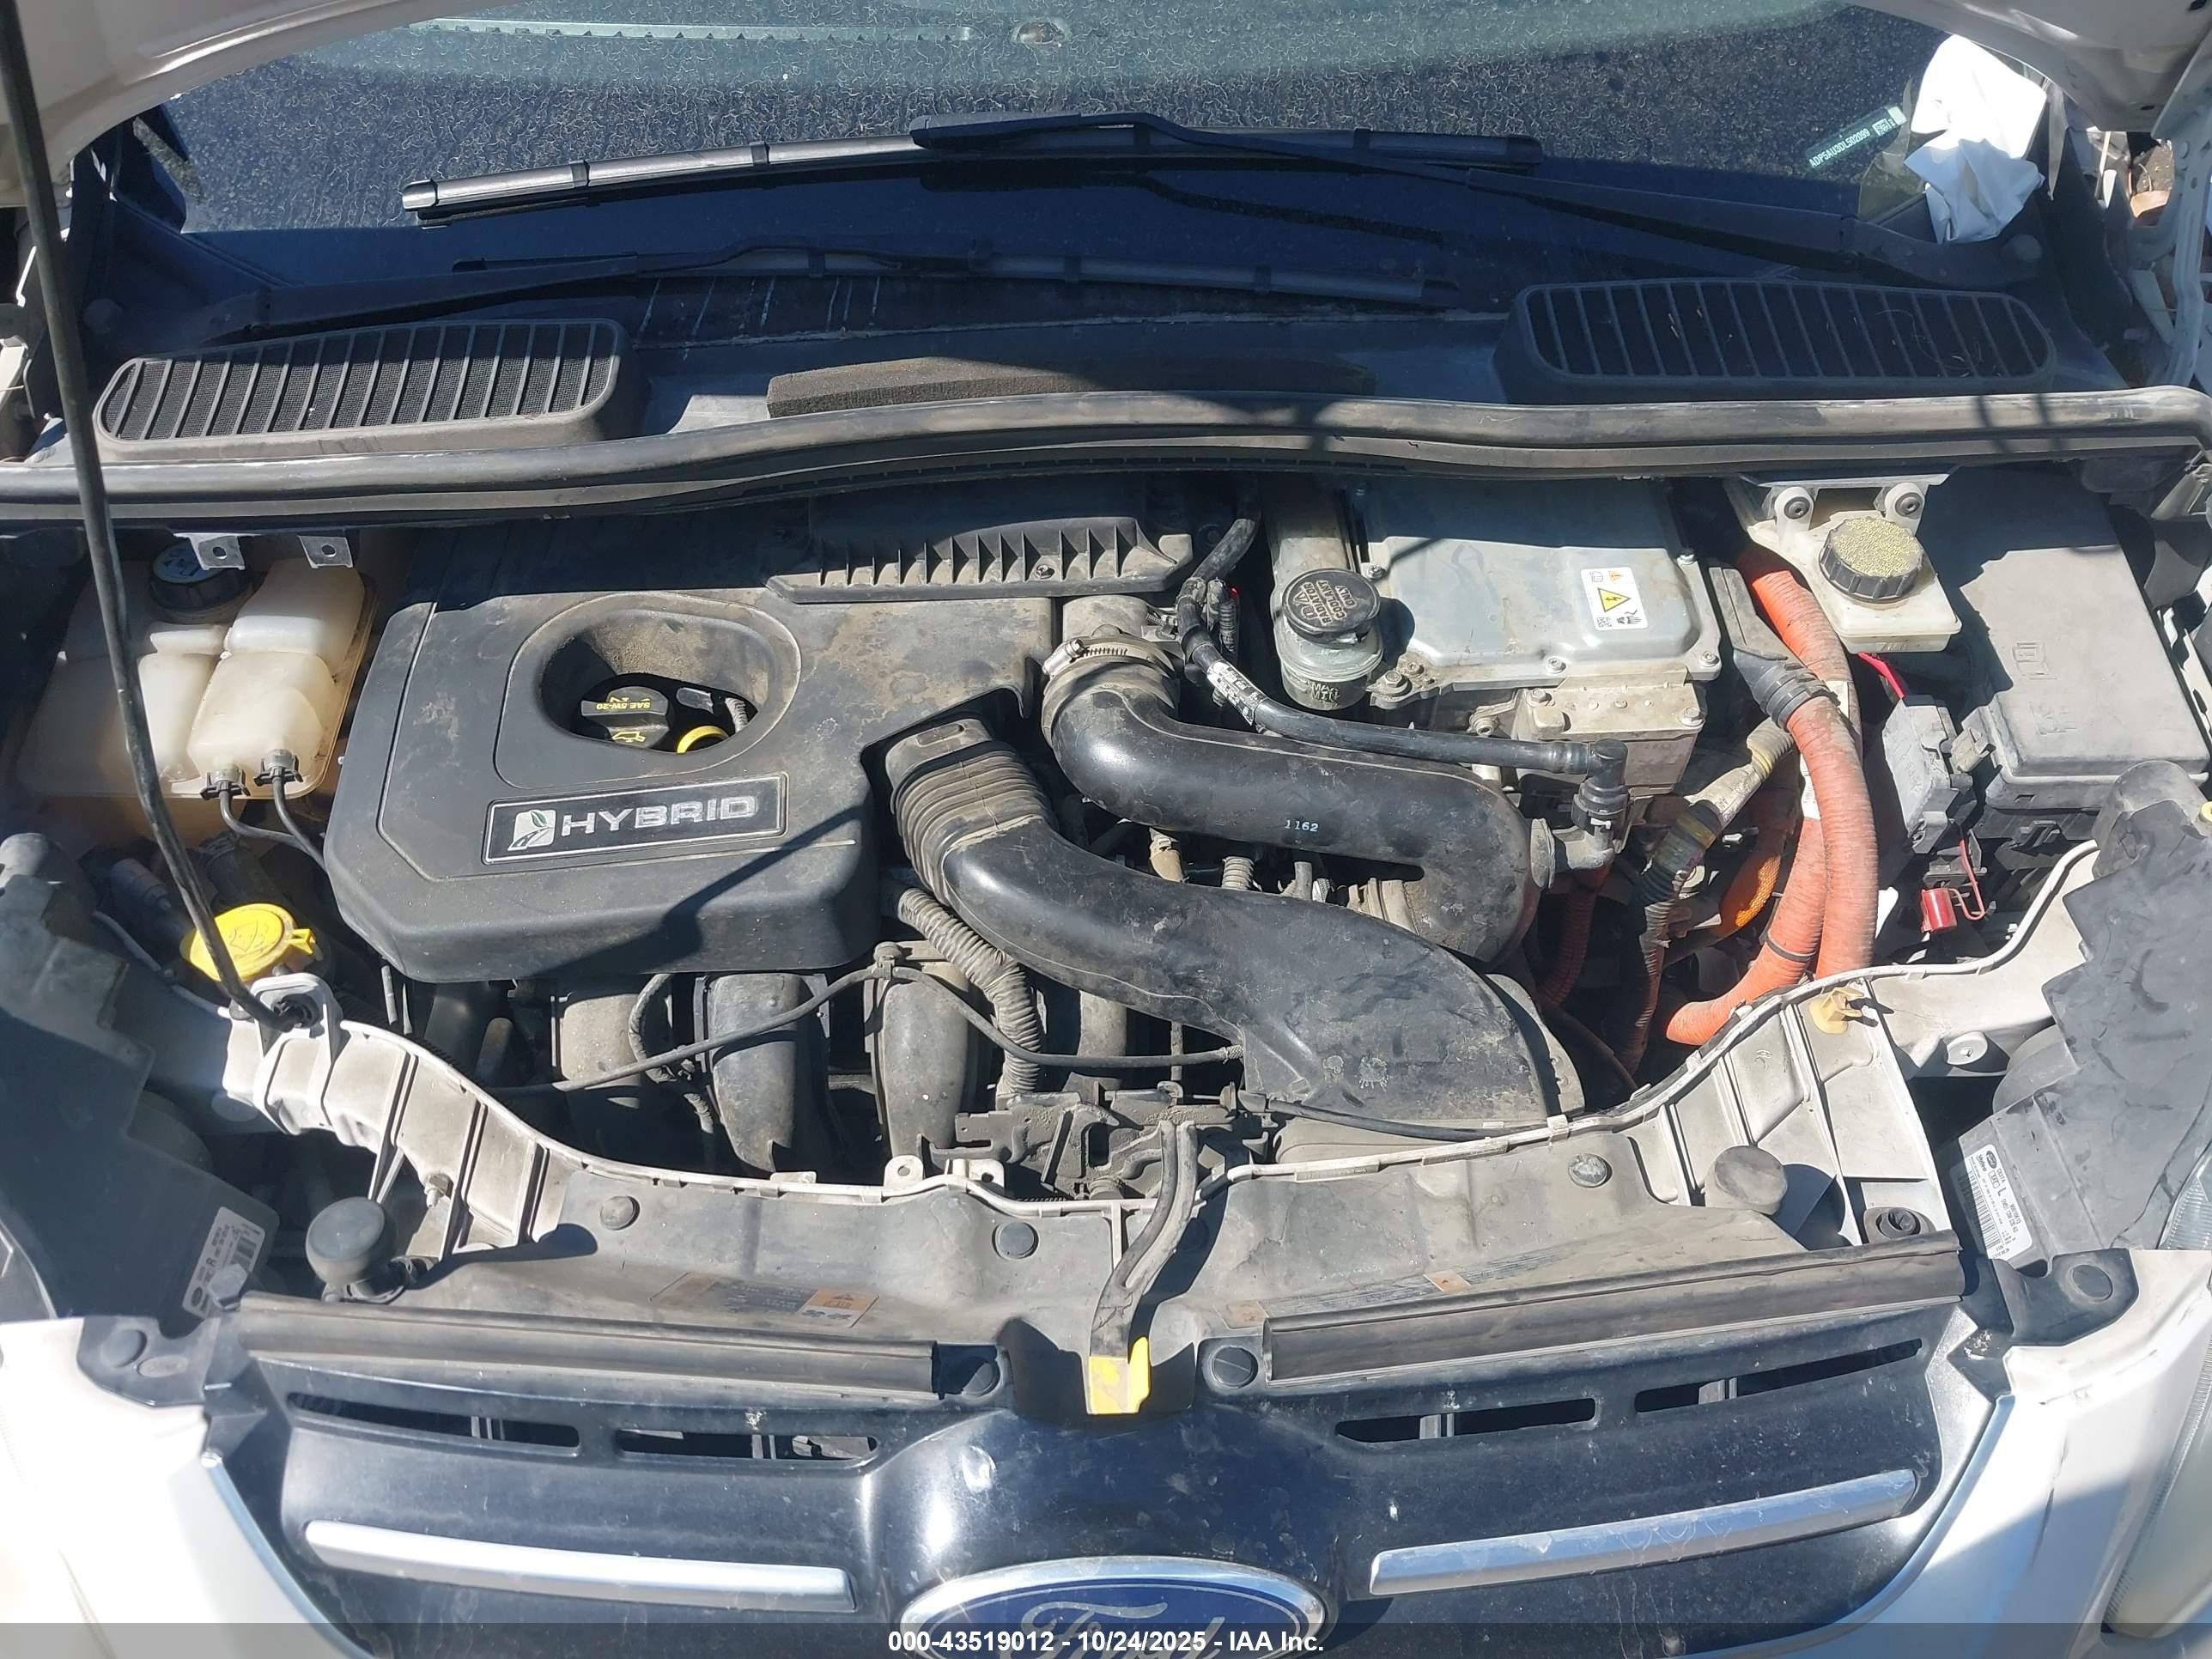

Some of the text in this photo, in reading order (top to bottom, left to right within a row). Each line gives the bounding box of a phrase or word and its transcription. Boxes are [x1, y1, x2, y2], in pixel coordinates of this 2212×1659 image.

[1303, 582, 1333, 625] RADIATOR
[1317, 580, 1346, 619] COOLANT
[1335, 586, 1356, 607] ONLY
[596, 702, 628, 710] 5W-20
[561, 795, 759, 837] HYBRID
[1284, 819, 1319, 832] 1162
